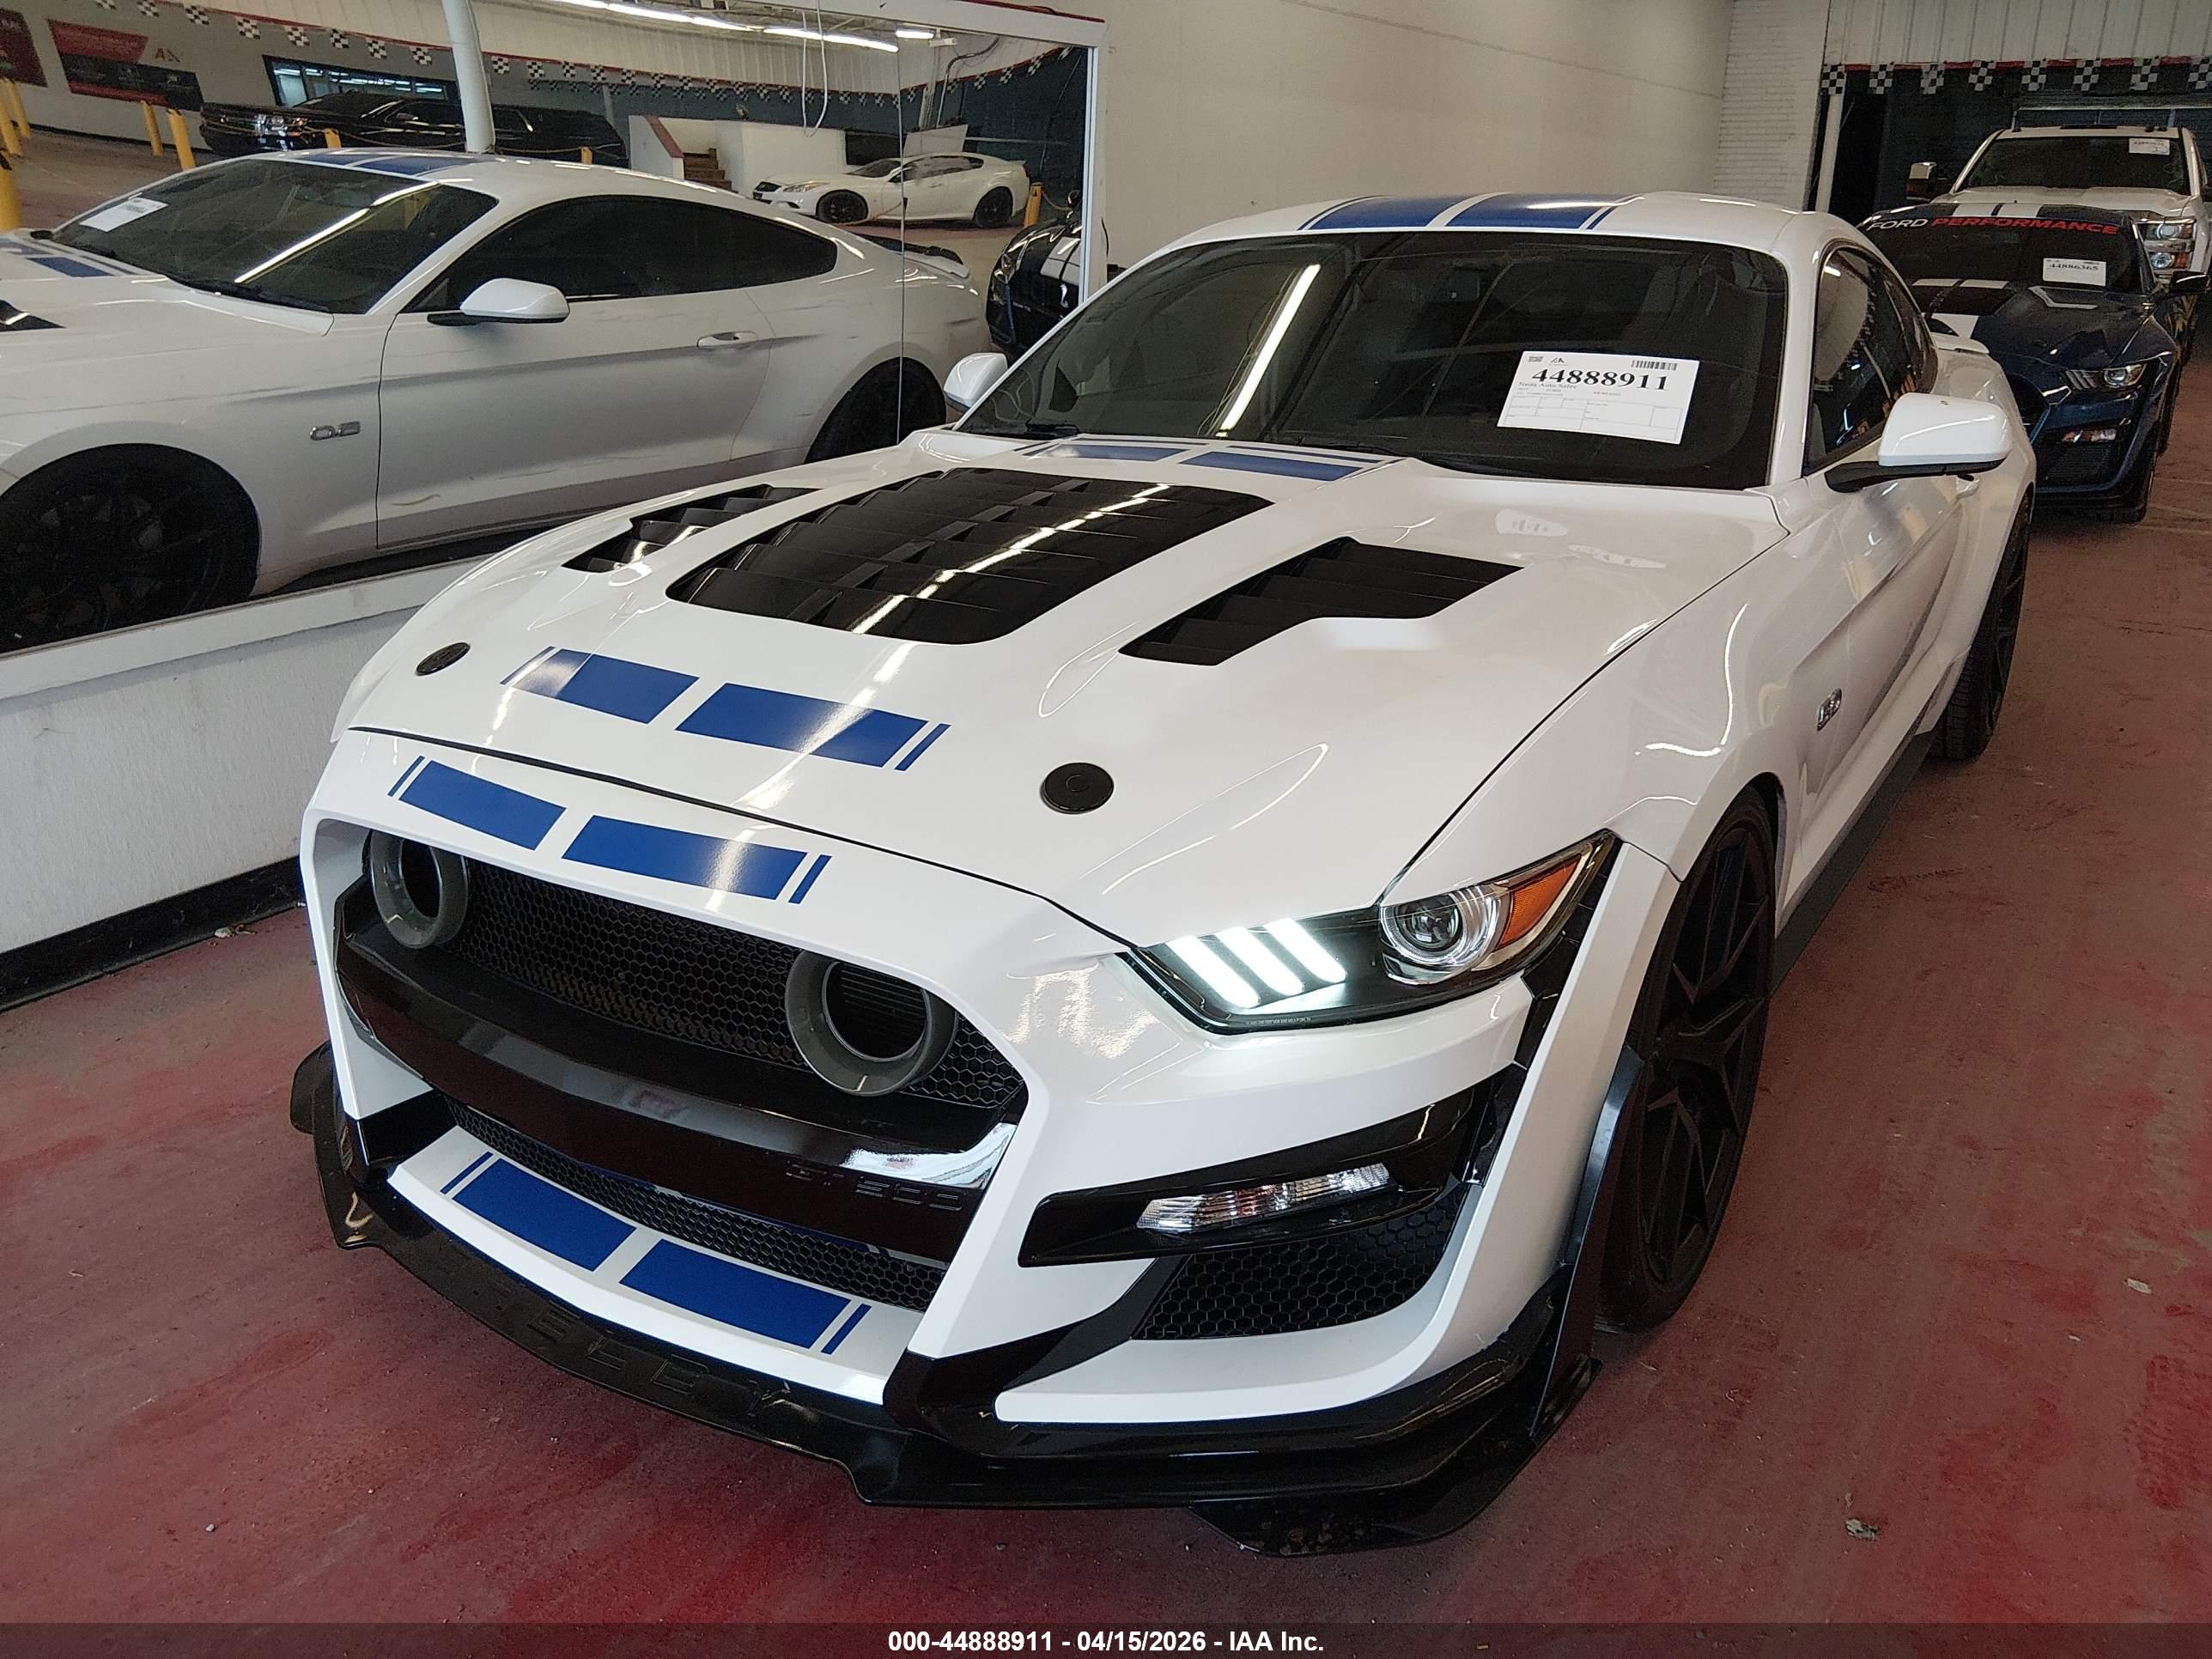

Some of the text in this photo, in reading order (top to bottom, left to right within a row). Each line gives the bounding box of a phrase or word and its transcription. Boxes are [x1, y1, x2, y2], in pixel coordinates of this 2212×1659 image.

[1866, 217, 2120, 234] FORD PERFORMANCE
[1531, 368, 1669, 392] 44888911
